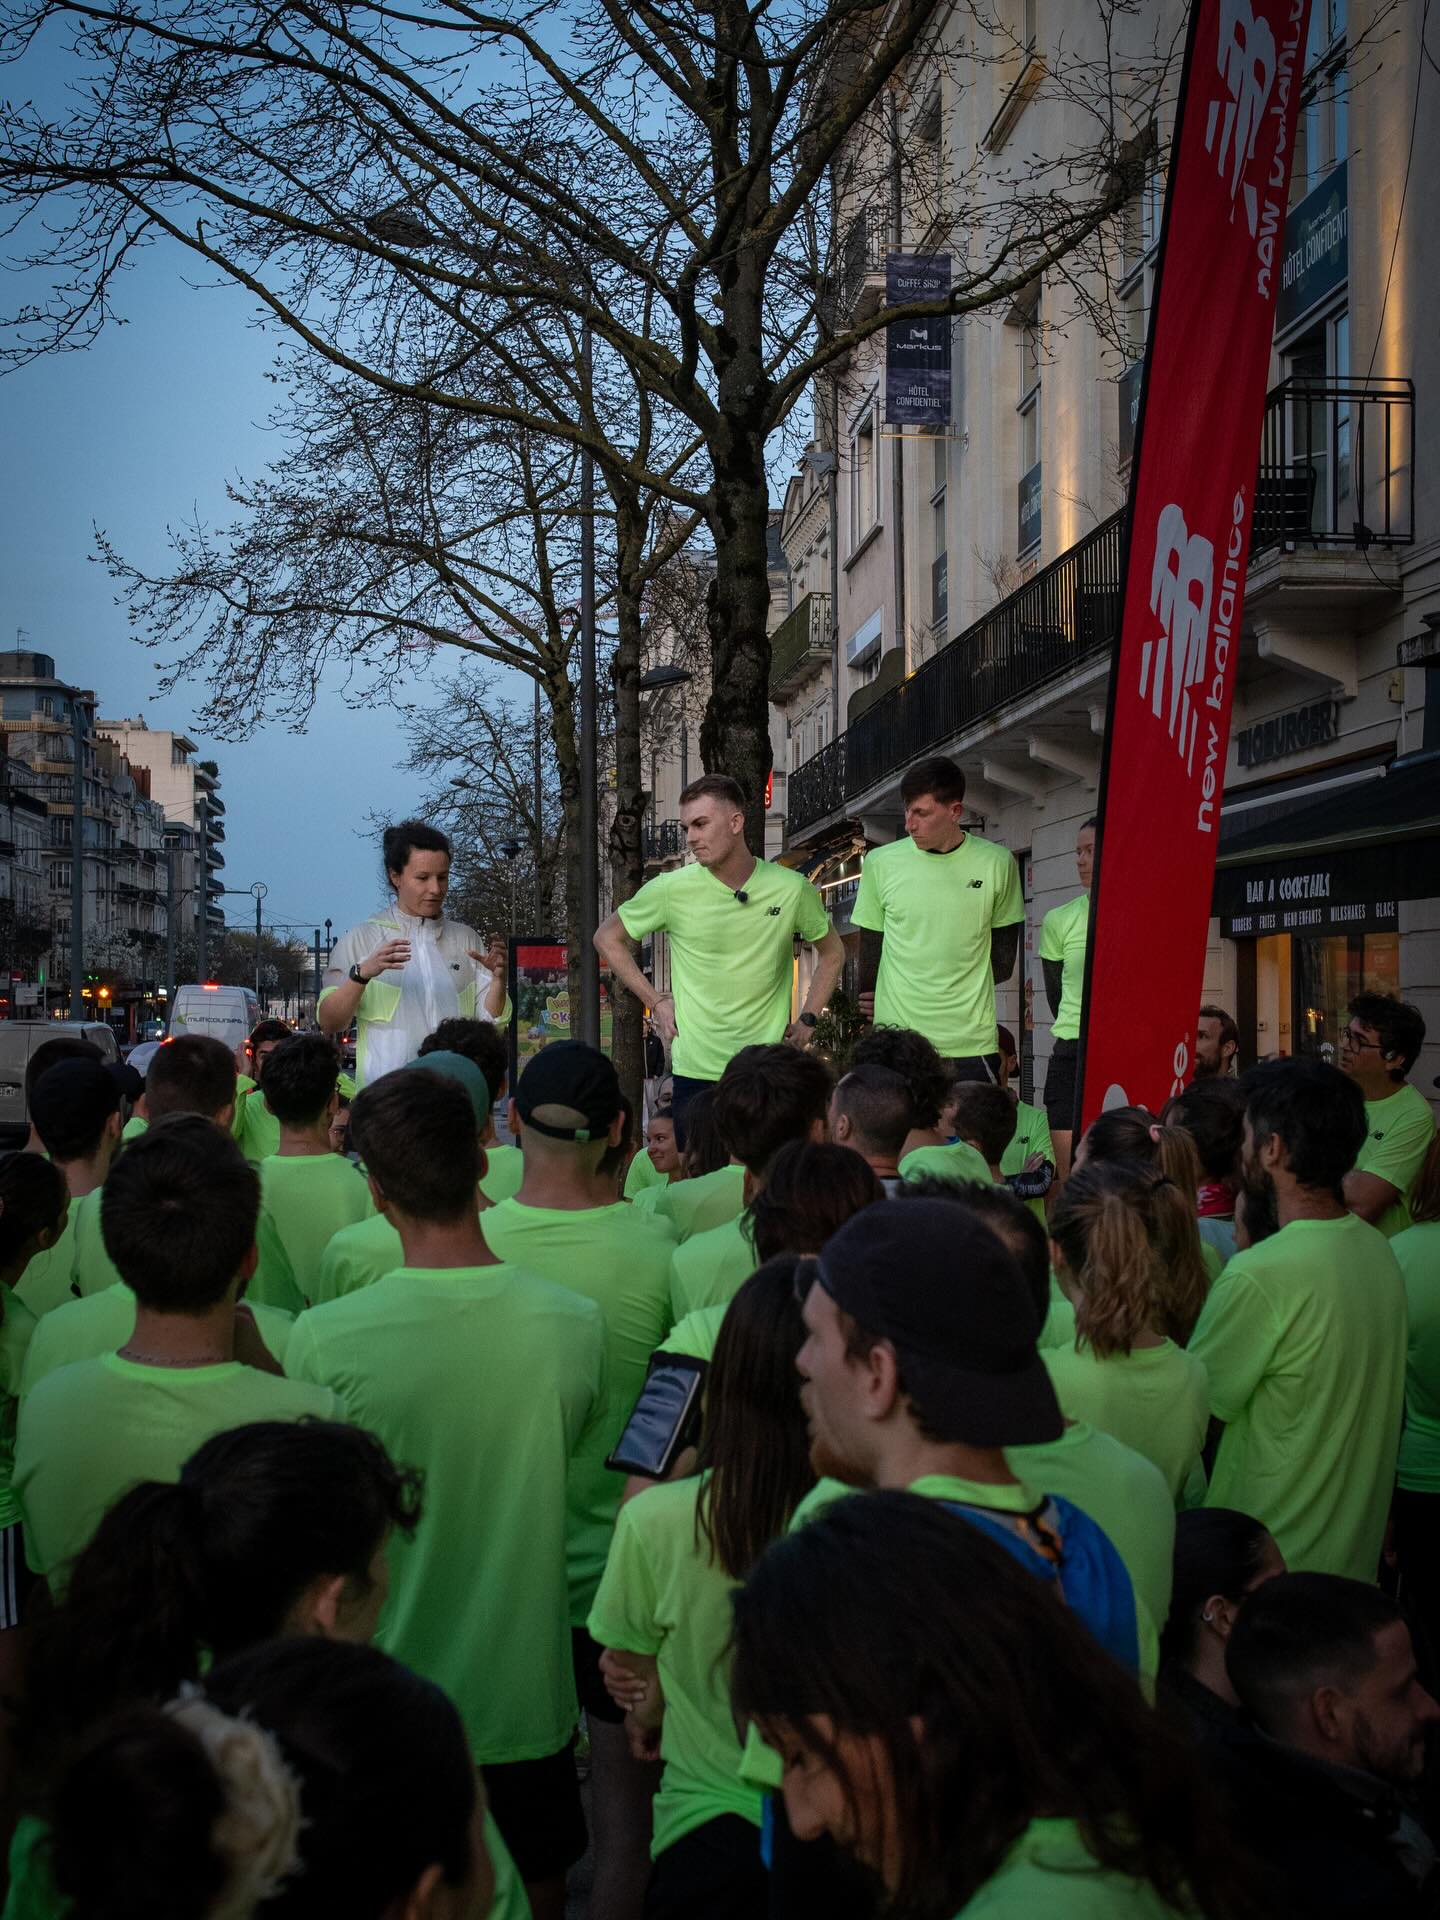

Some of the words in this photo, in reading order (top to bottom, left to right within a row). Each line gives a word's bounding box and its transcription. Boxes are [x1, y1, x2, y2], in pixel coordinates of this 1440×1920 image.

[1282, 248, 1305, 292] HÔTEL
[896, 396, 942, 408] CONFIDENTIEL
[908, 384, 929, 397] HÔTEL
[1206, 489, 1245, 711] balance
[1197, 721, 1219, 833] new
[1246, 880, 1264, 903] BAR
[1279, 872, 1331, 900] COCKTAILS
